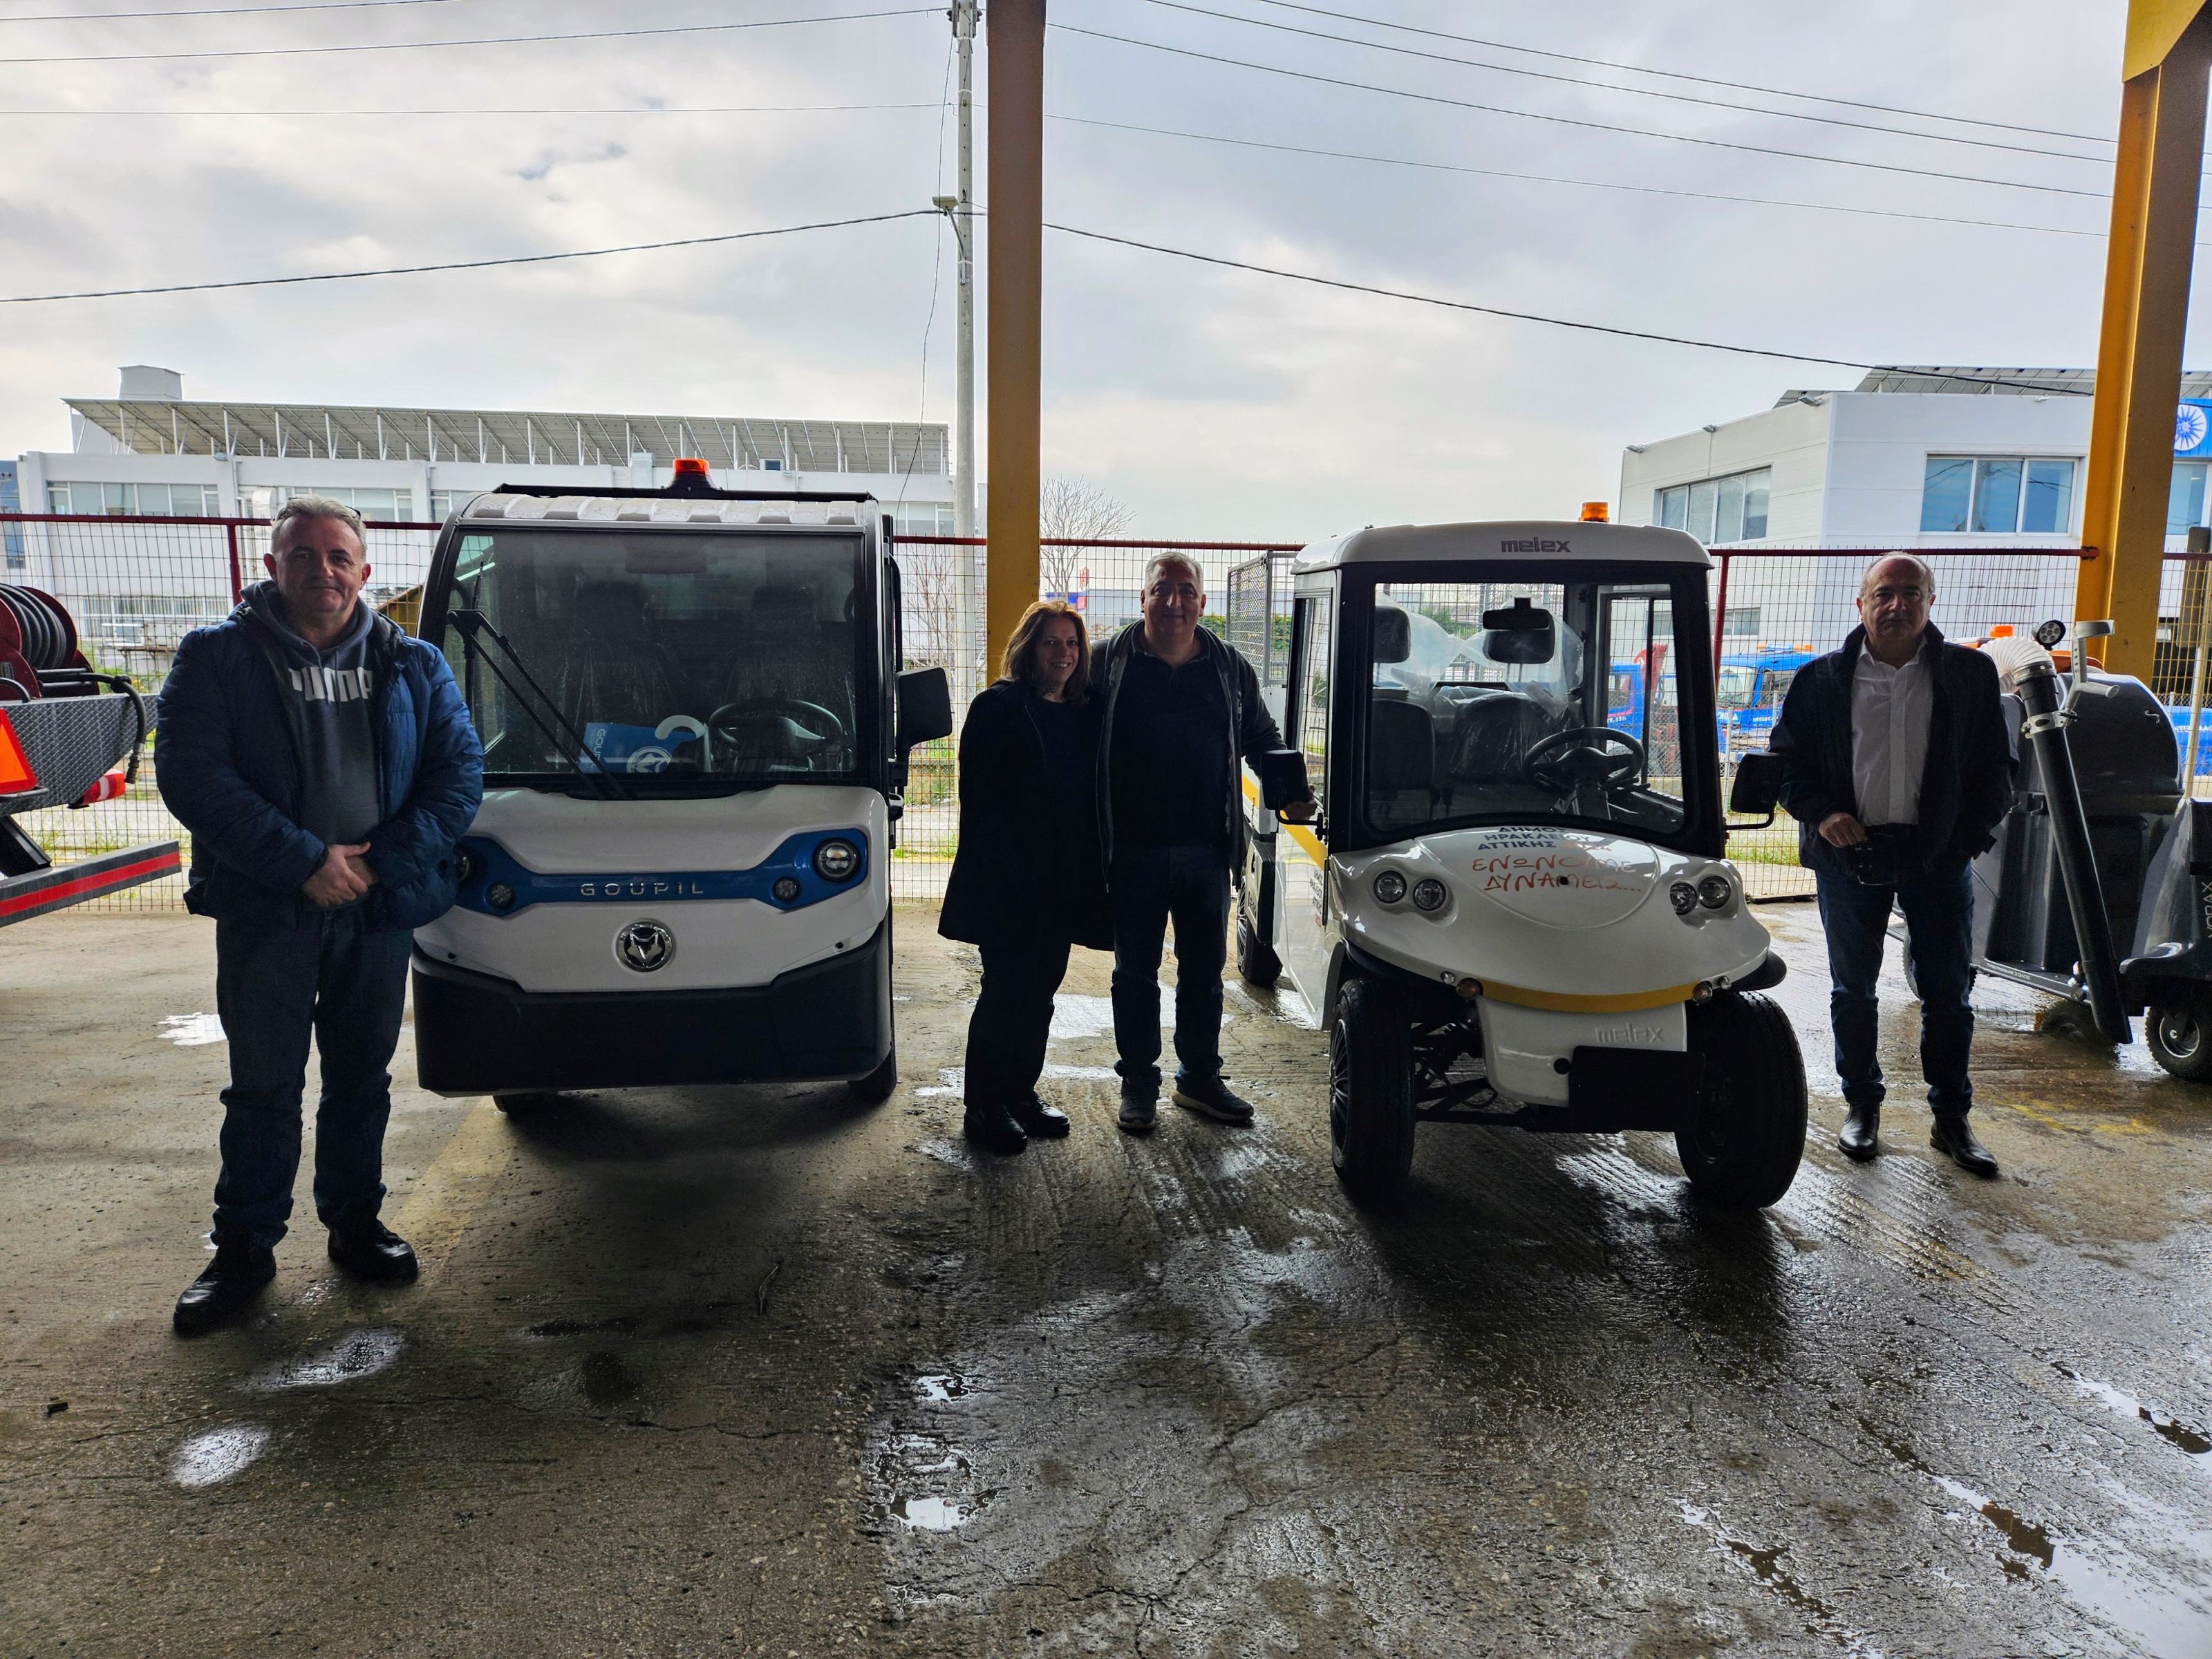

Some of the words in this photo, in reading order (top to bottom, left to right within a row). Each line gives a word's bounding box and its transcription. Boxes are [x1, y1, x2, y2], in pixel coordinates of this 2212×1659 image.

[1501, 536, 1571, 552] melex
[1477, 841, 1557, 850] ΑΤΤΙΚΗΣ
[580, 882, 704, 896] GOUPIL
[1594, 1022, 1665, 1042] melex
